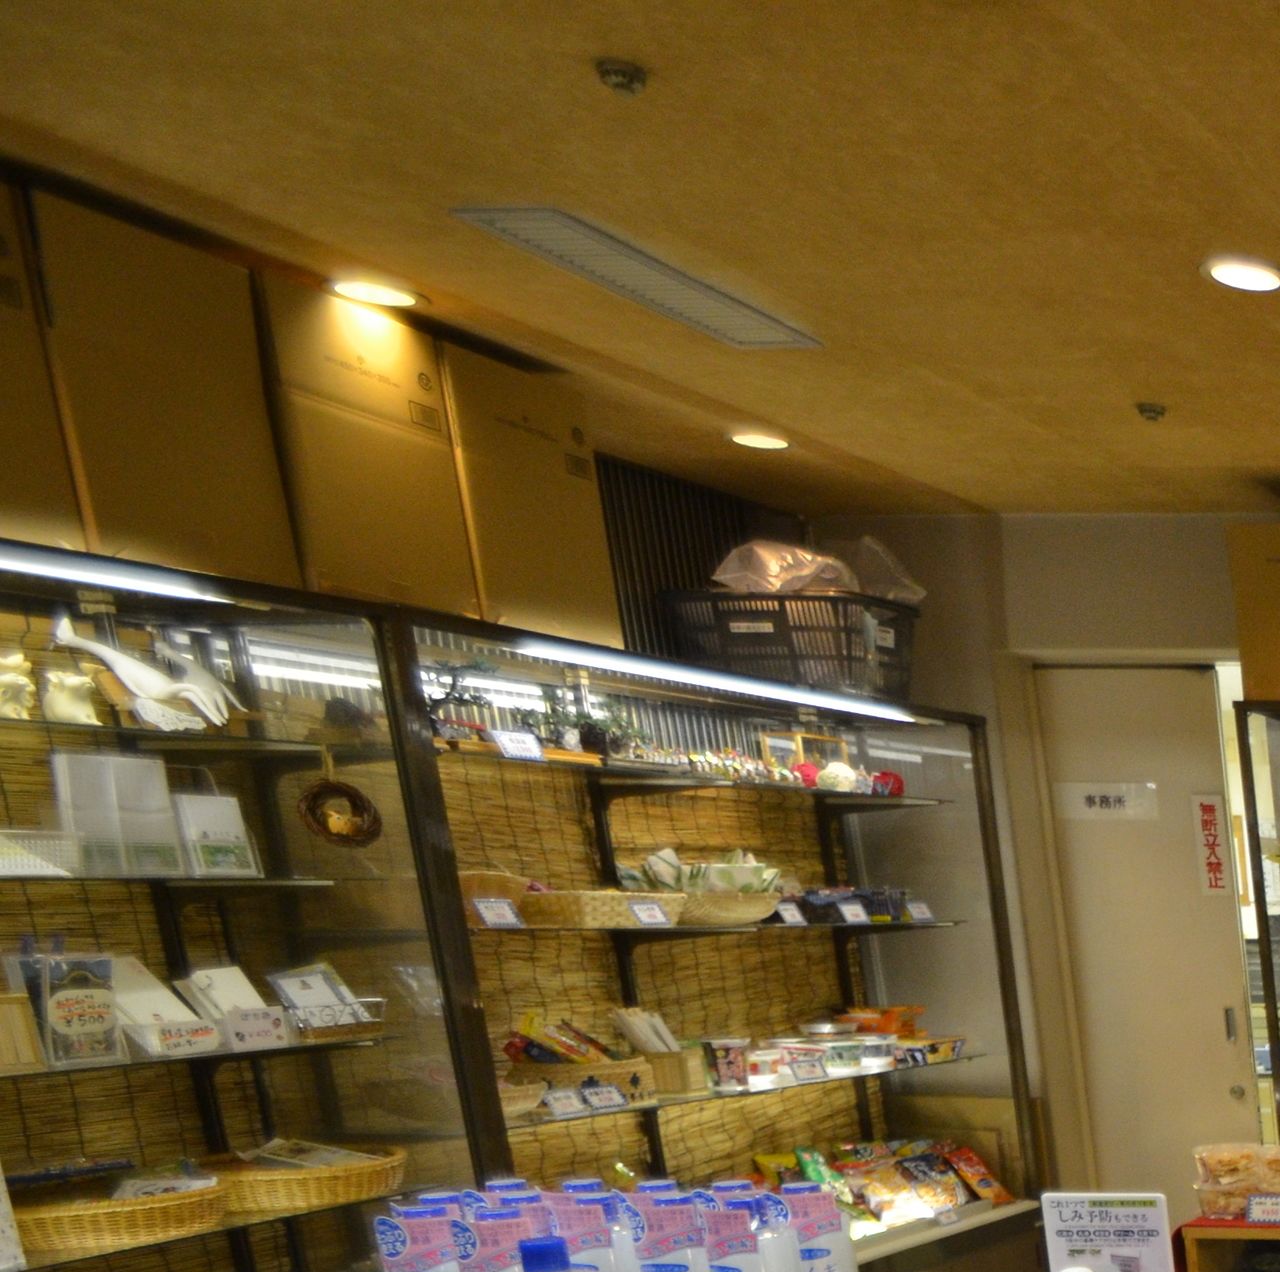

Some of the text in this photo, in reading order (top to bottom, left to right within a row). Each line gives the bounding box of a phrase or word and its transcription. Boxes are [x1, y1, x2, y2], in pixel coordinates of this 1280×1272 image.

[1083, 794, 1127, 811] 事務所
[1198, 801, 1226, 889] 無断立入禁止
[64, 1015, 104, 1027] ¥500
